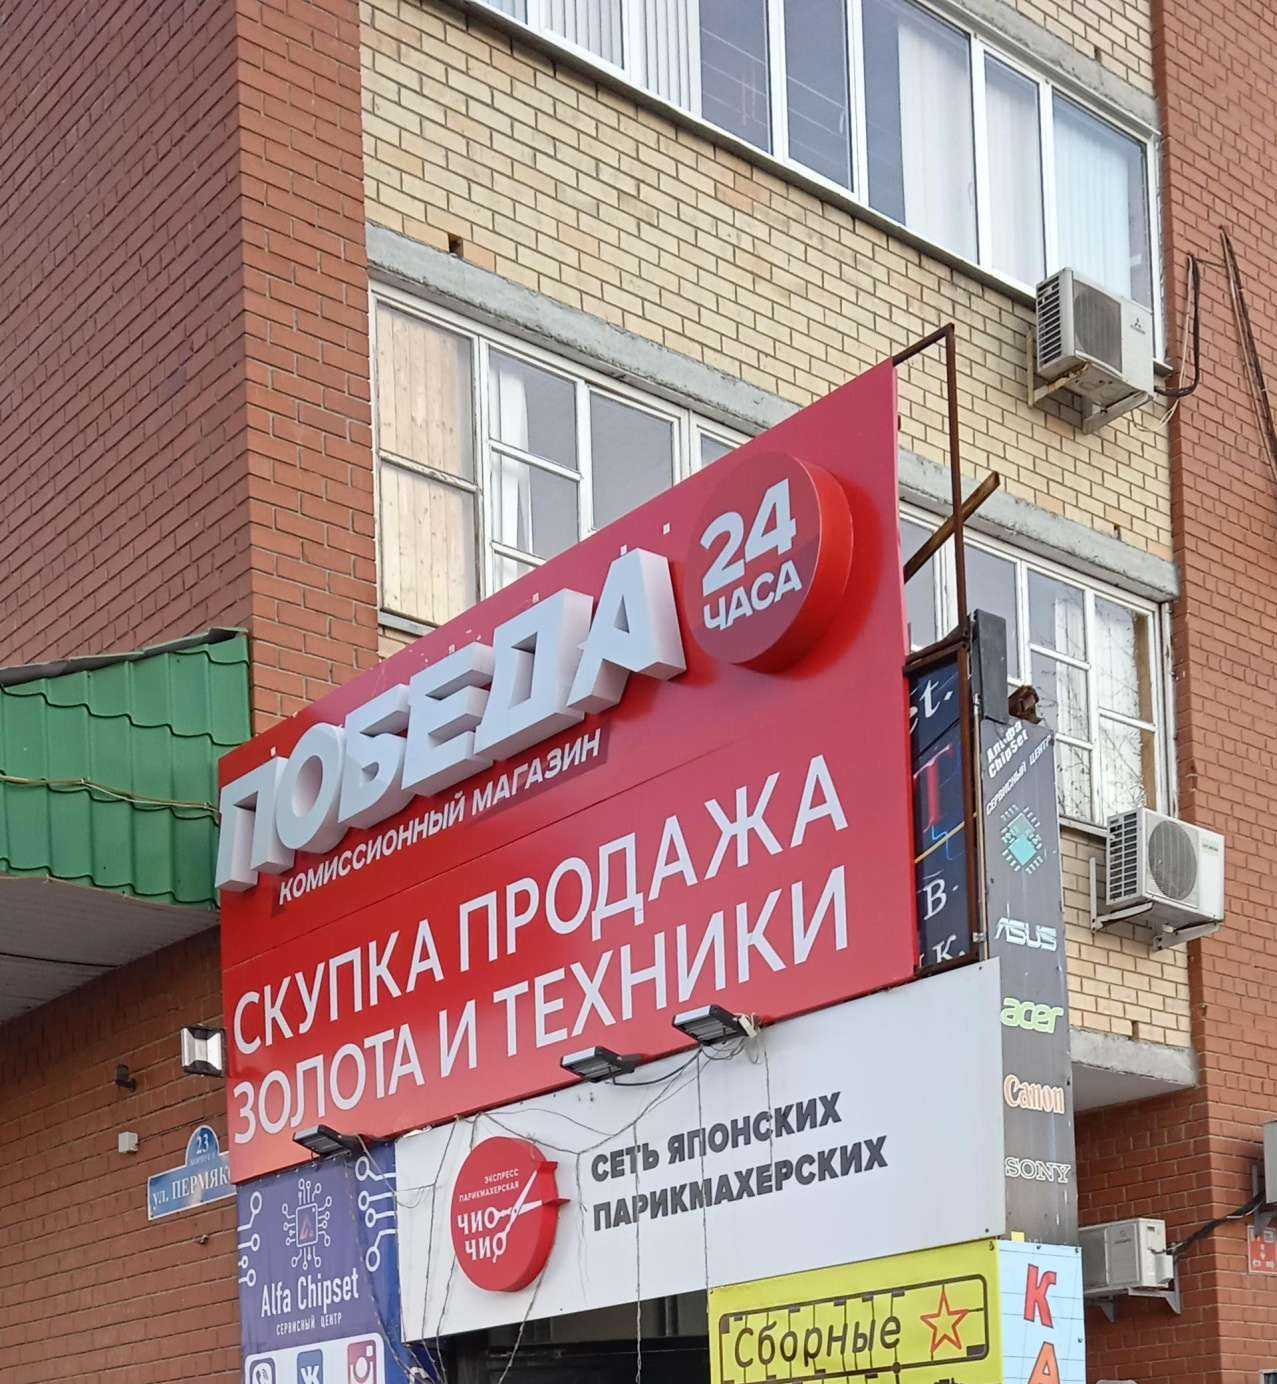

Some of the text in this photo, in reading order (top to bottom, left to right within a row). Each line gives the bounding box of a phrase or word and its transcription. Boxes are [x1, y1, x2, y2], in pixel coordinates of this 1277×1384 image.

[700, 479, 797, 595] 24
[704, 561, 802, 631] ЧАСА
[216, 547, 687, 892] ПОБЕДА
[986, 734, 1051, 816] СЕРВИСНЫЙ ЦЕНТР
[278, 728, 602, 905] КОМИССИОННЫЙ МАГАЗИН
[233, 754, 849, 1056] СКУПКА ПРОДАЖА
[995, 917, 1057, 951] ASUS
[233, 865, 849, 1145] ЗОЛОТА И ТЕХНИКИ
[1000, 997, 1064, 1034] acer
[1003, 1074, 1065, 1114] Canon
[196, 1133, 209, 1154] 23
[591, 1091, 842, 1182] СЕТЬ ЯПОНСКИХ
[152, 1165, 231, 1211] ул. ПЕРМЯК
[459, 1181, 520, 1202] ПАРИКМАХЕРСКАЯ
[484, 1168, 520, 1184] ЭКСПРЕСС
[593, 1135, 888, 1231] ПАРИКМАХЕРСКИХ
[1005, 1157, 1071, 1183] SONY
[457, 1207, 499, 1235] ЧИО
[465, 1232, 506, 1263] ЧИО
[261, 1267, 359, 1318] Alfa Chipset
[276, 1312, 342, 1336] СЕРВИСНЫЙ ЦЕНТР
[734, 1314, 901, 1368] Сборные
